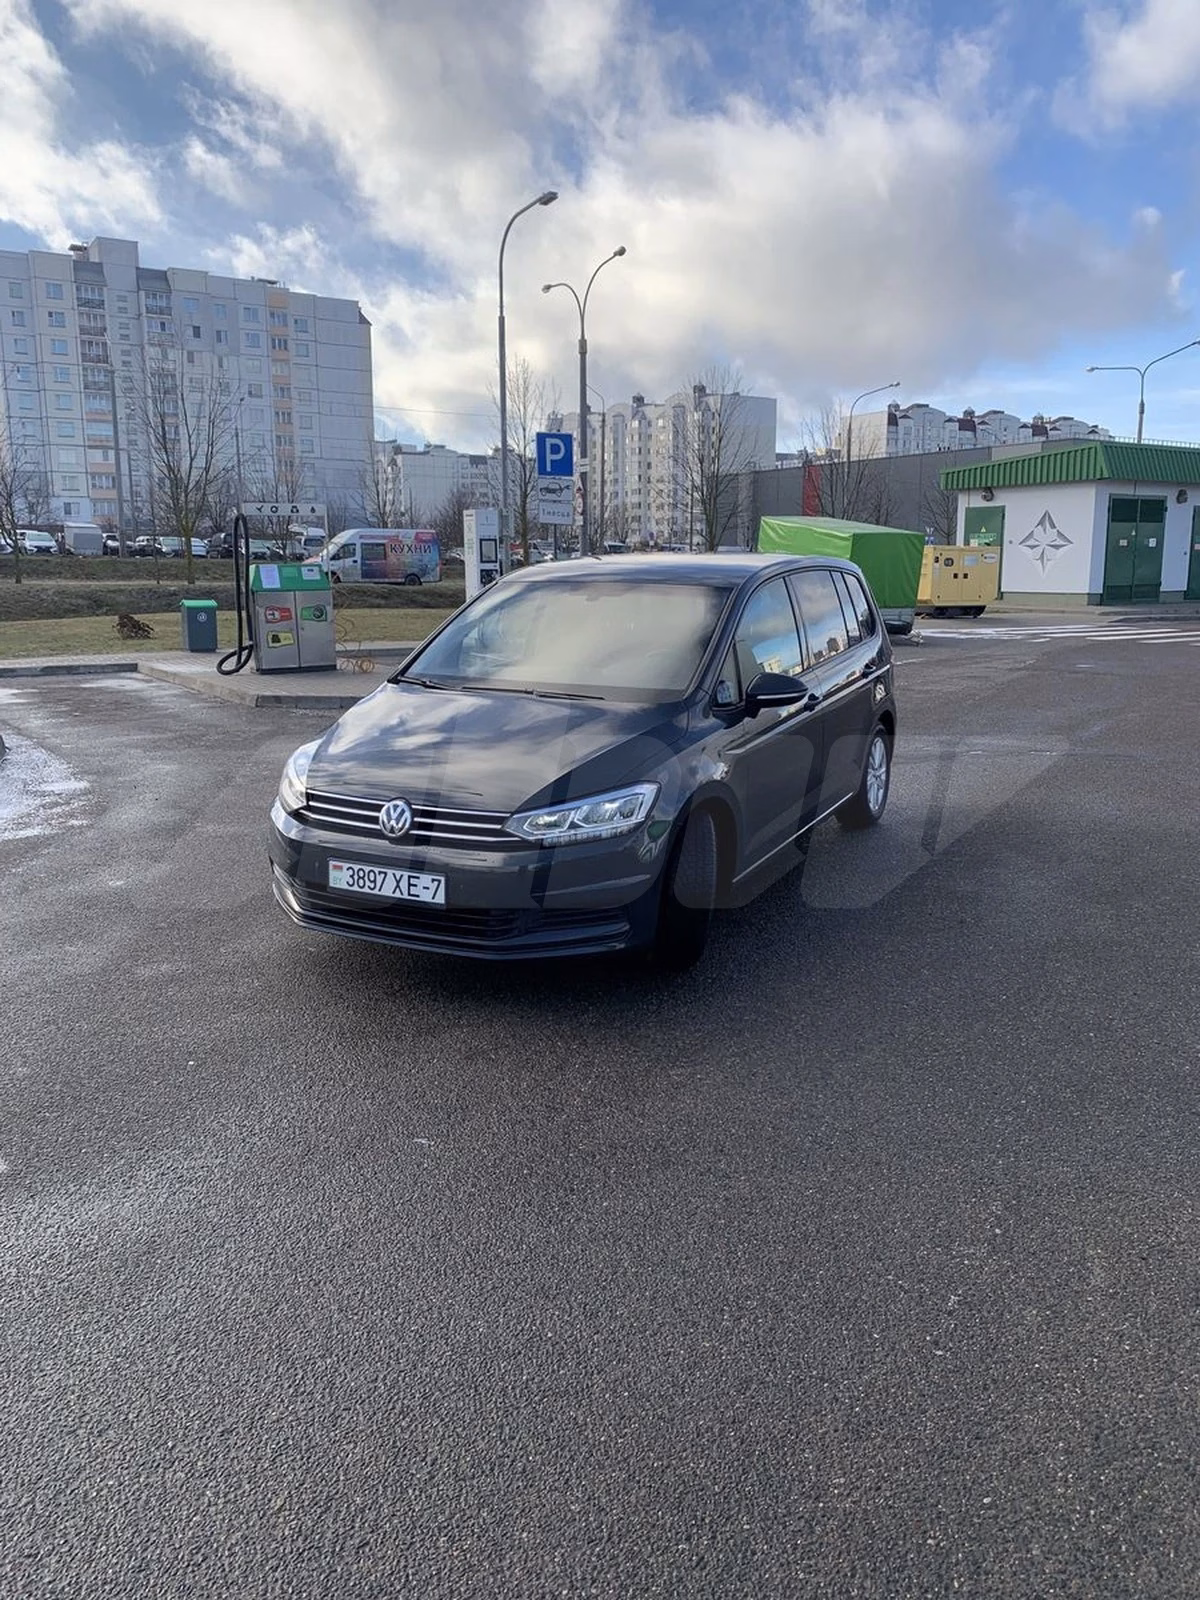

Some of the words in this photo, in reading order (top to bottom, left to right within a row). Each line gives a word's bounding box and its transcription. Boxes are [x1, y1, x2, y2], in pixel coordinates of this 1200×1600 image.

[545, 438, 565, 471] P
[390, 544, 432, 554] КУХНИ
[346, 866, 388, 893] 3897
[391, 872, 442, 901] XE-7
